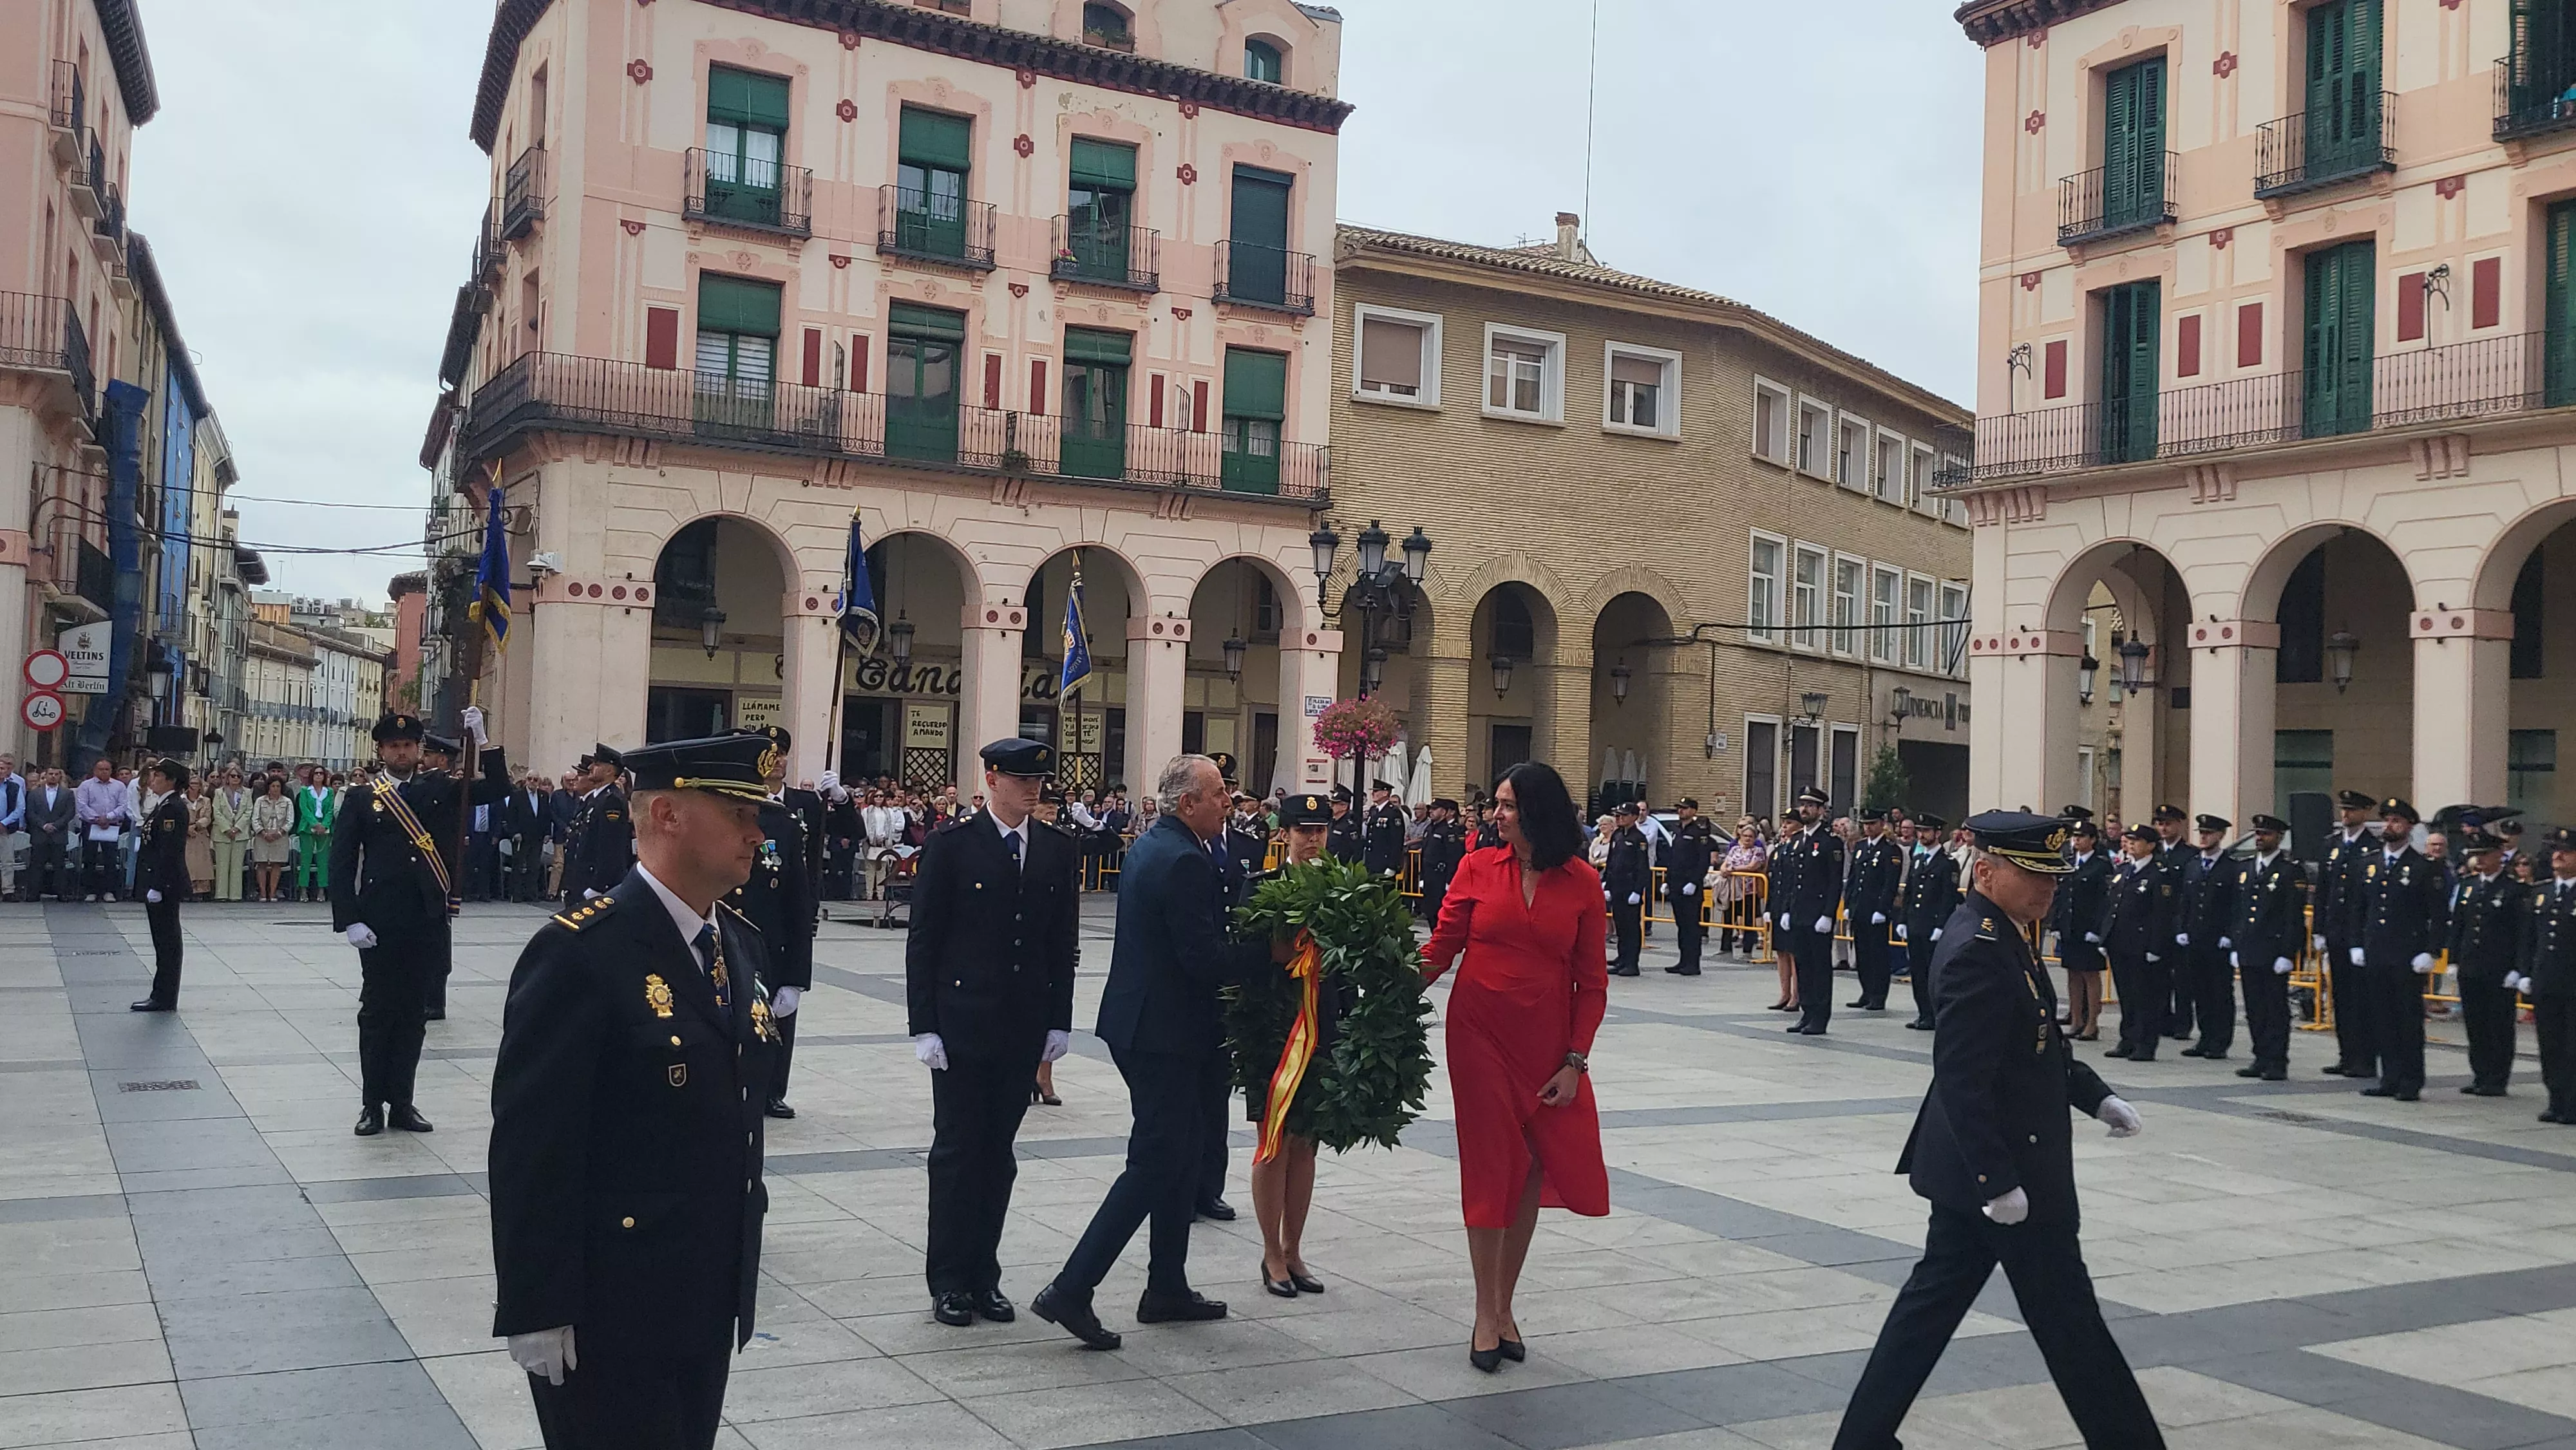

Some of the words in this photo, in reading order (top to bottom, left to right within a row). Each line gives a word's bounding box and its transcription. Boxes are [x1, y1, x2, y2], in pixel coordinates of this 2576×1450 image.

[64, 650, 104, 661] VELTINS
[77, 680, 104, 690] Berlin
[743, 701, 781, 711] LLÁMAME
